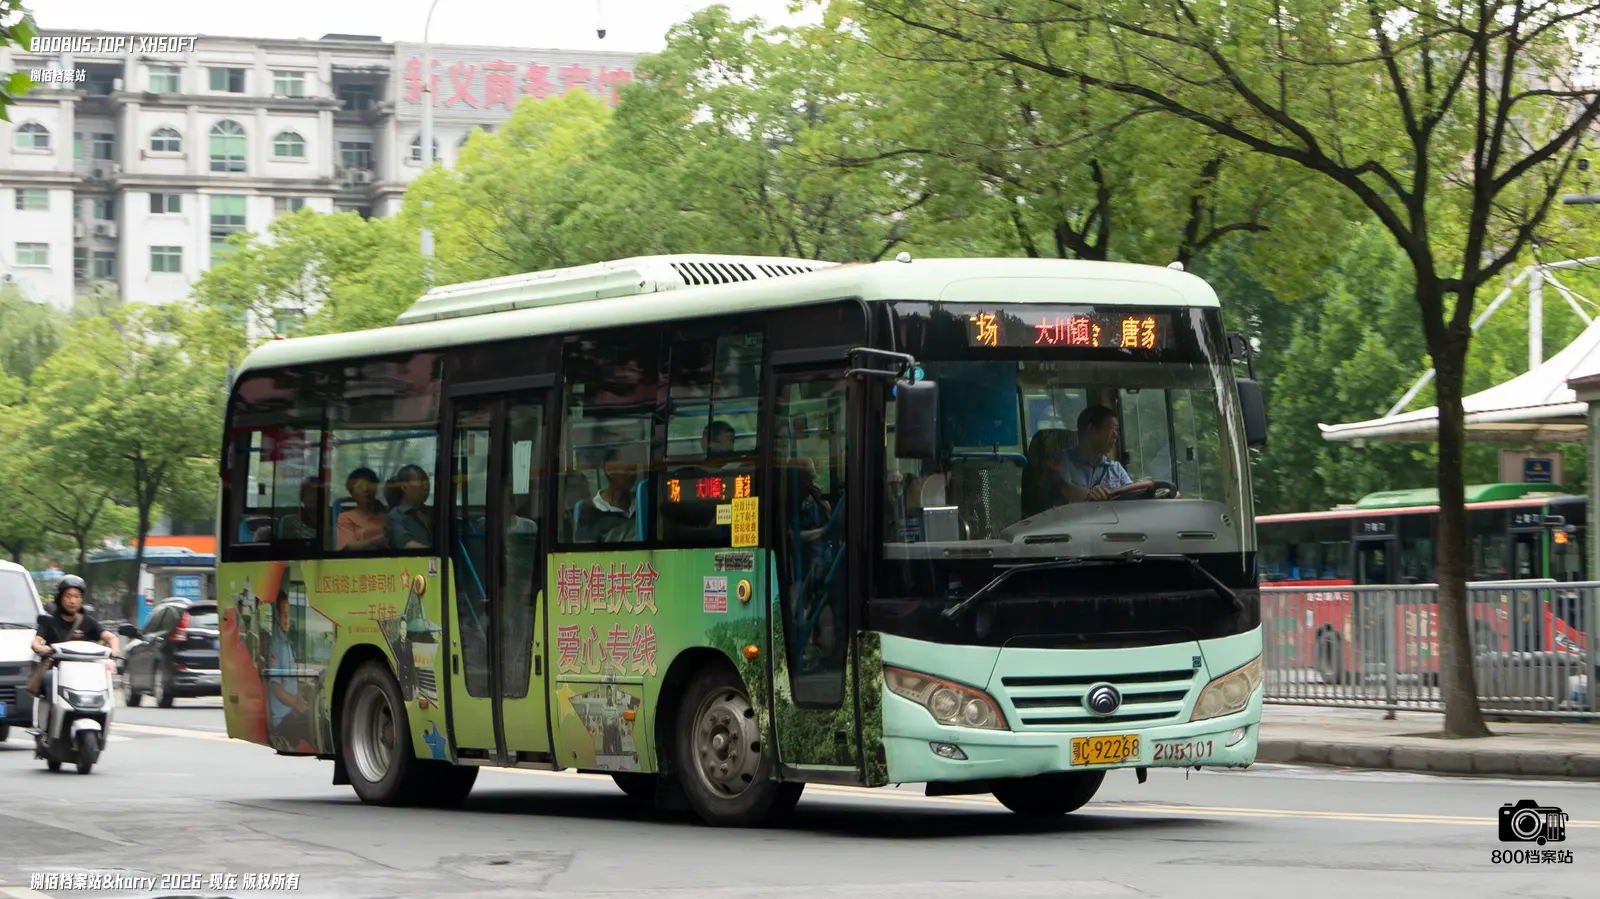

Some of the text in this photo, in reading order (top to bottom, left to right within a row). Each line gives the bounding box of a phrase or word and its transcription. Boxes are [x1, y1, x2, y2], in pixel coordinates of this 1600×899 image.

[557, 561, 659, 616] 精准扶贫
[557, 624, 658, 677] 爱心专线
[1153, 741, 1213, 761] 205101
